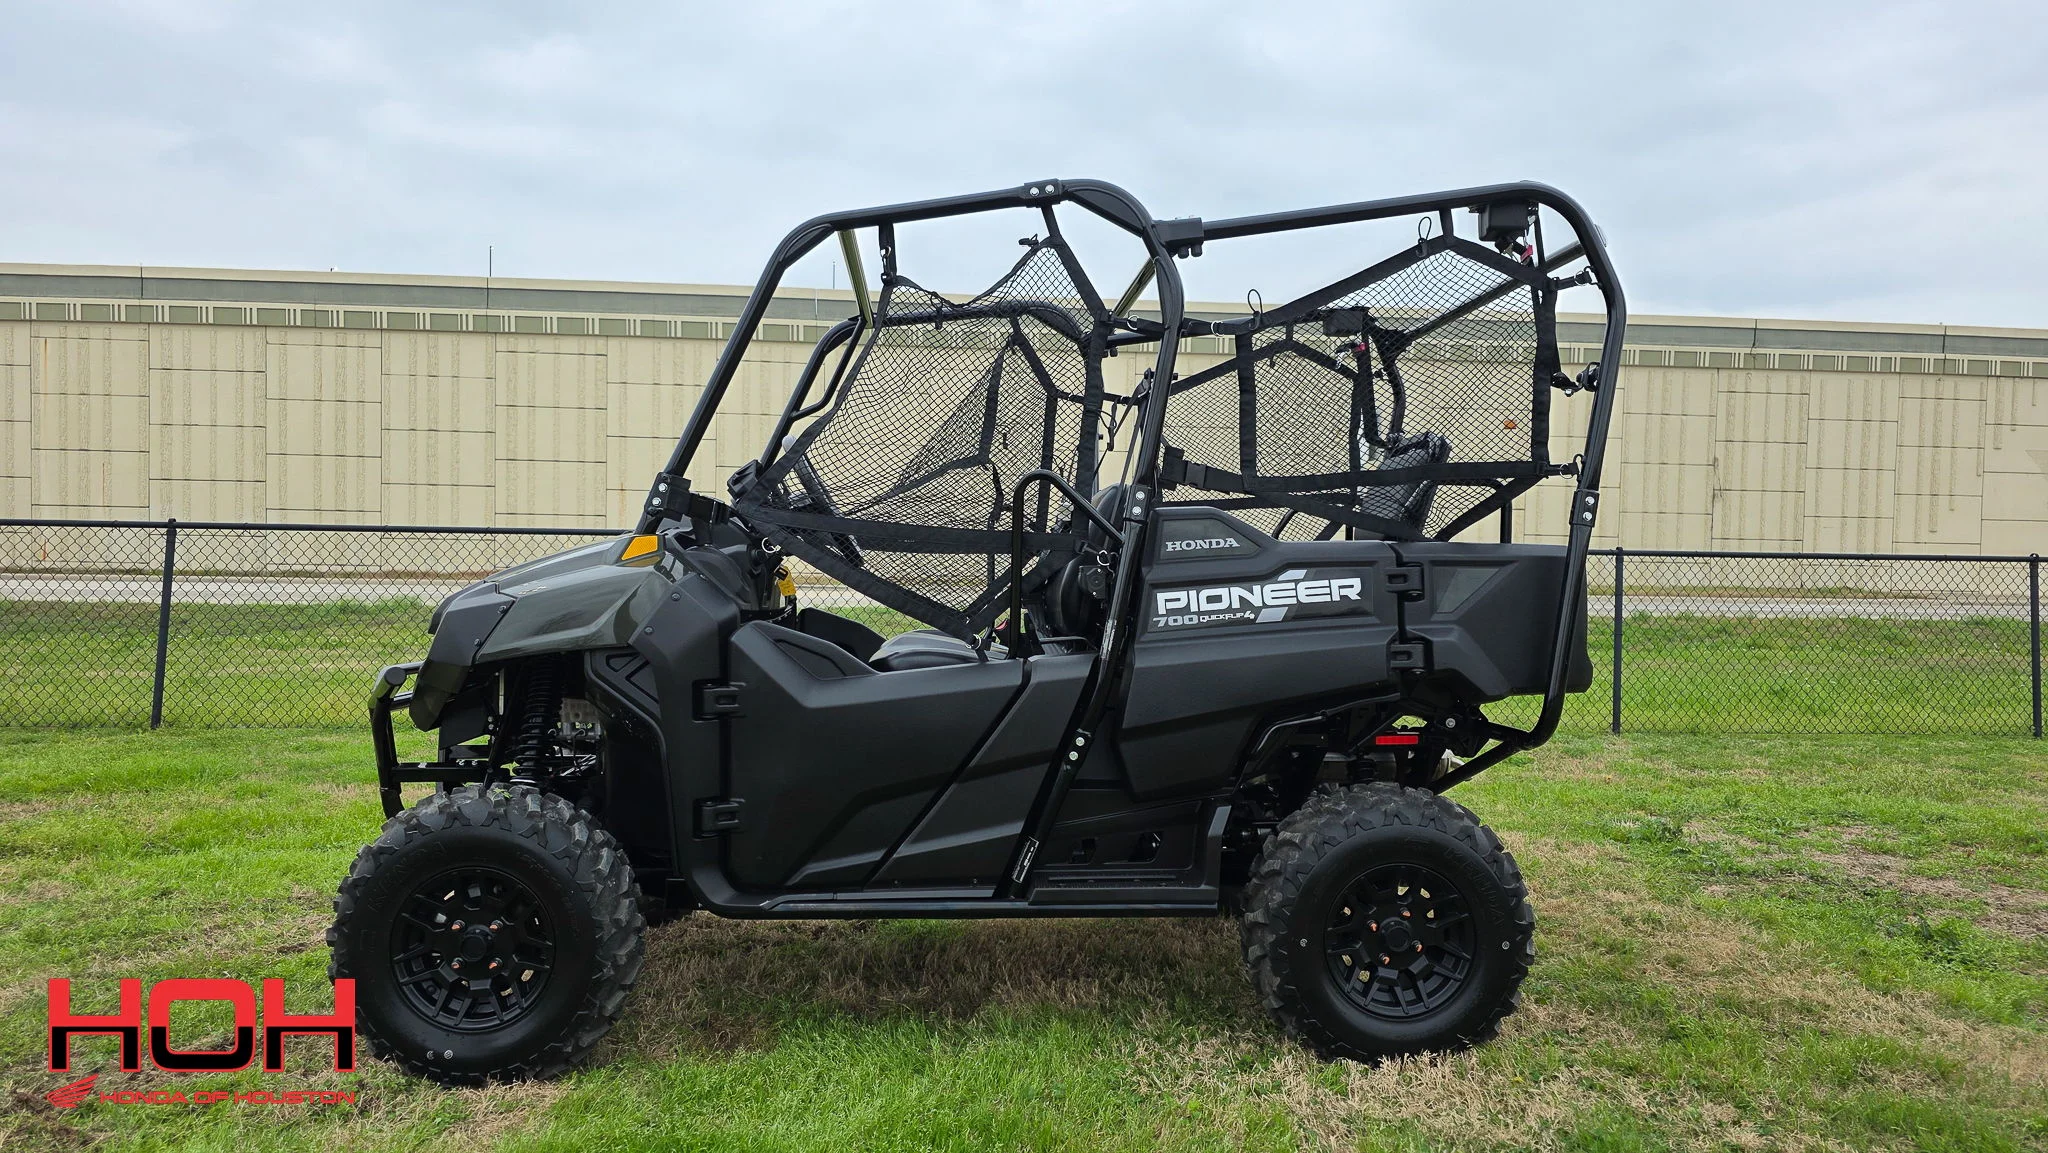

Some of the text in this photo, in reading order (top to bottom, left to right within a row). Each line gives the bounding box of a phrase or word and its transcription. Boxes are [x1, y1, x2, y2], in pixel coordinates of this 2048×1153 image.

[1166, 537, 1240, 551] HONDA
[1156, 577, 1362, 615] PIONEER
[1152, 614, 1199, 627] 700
